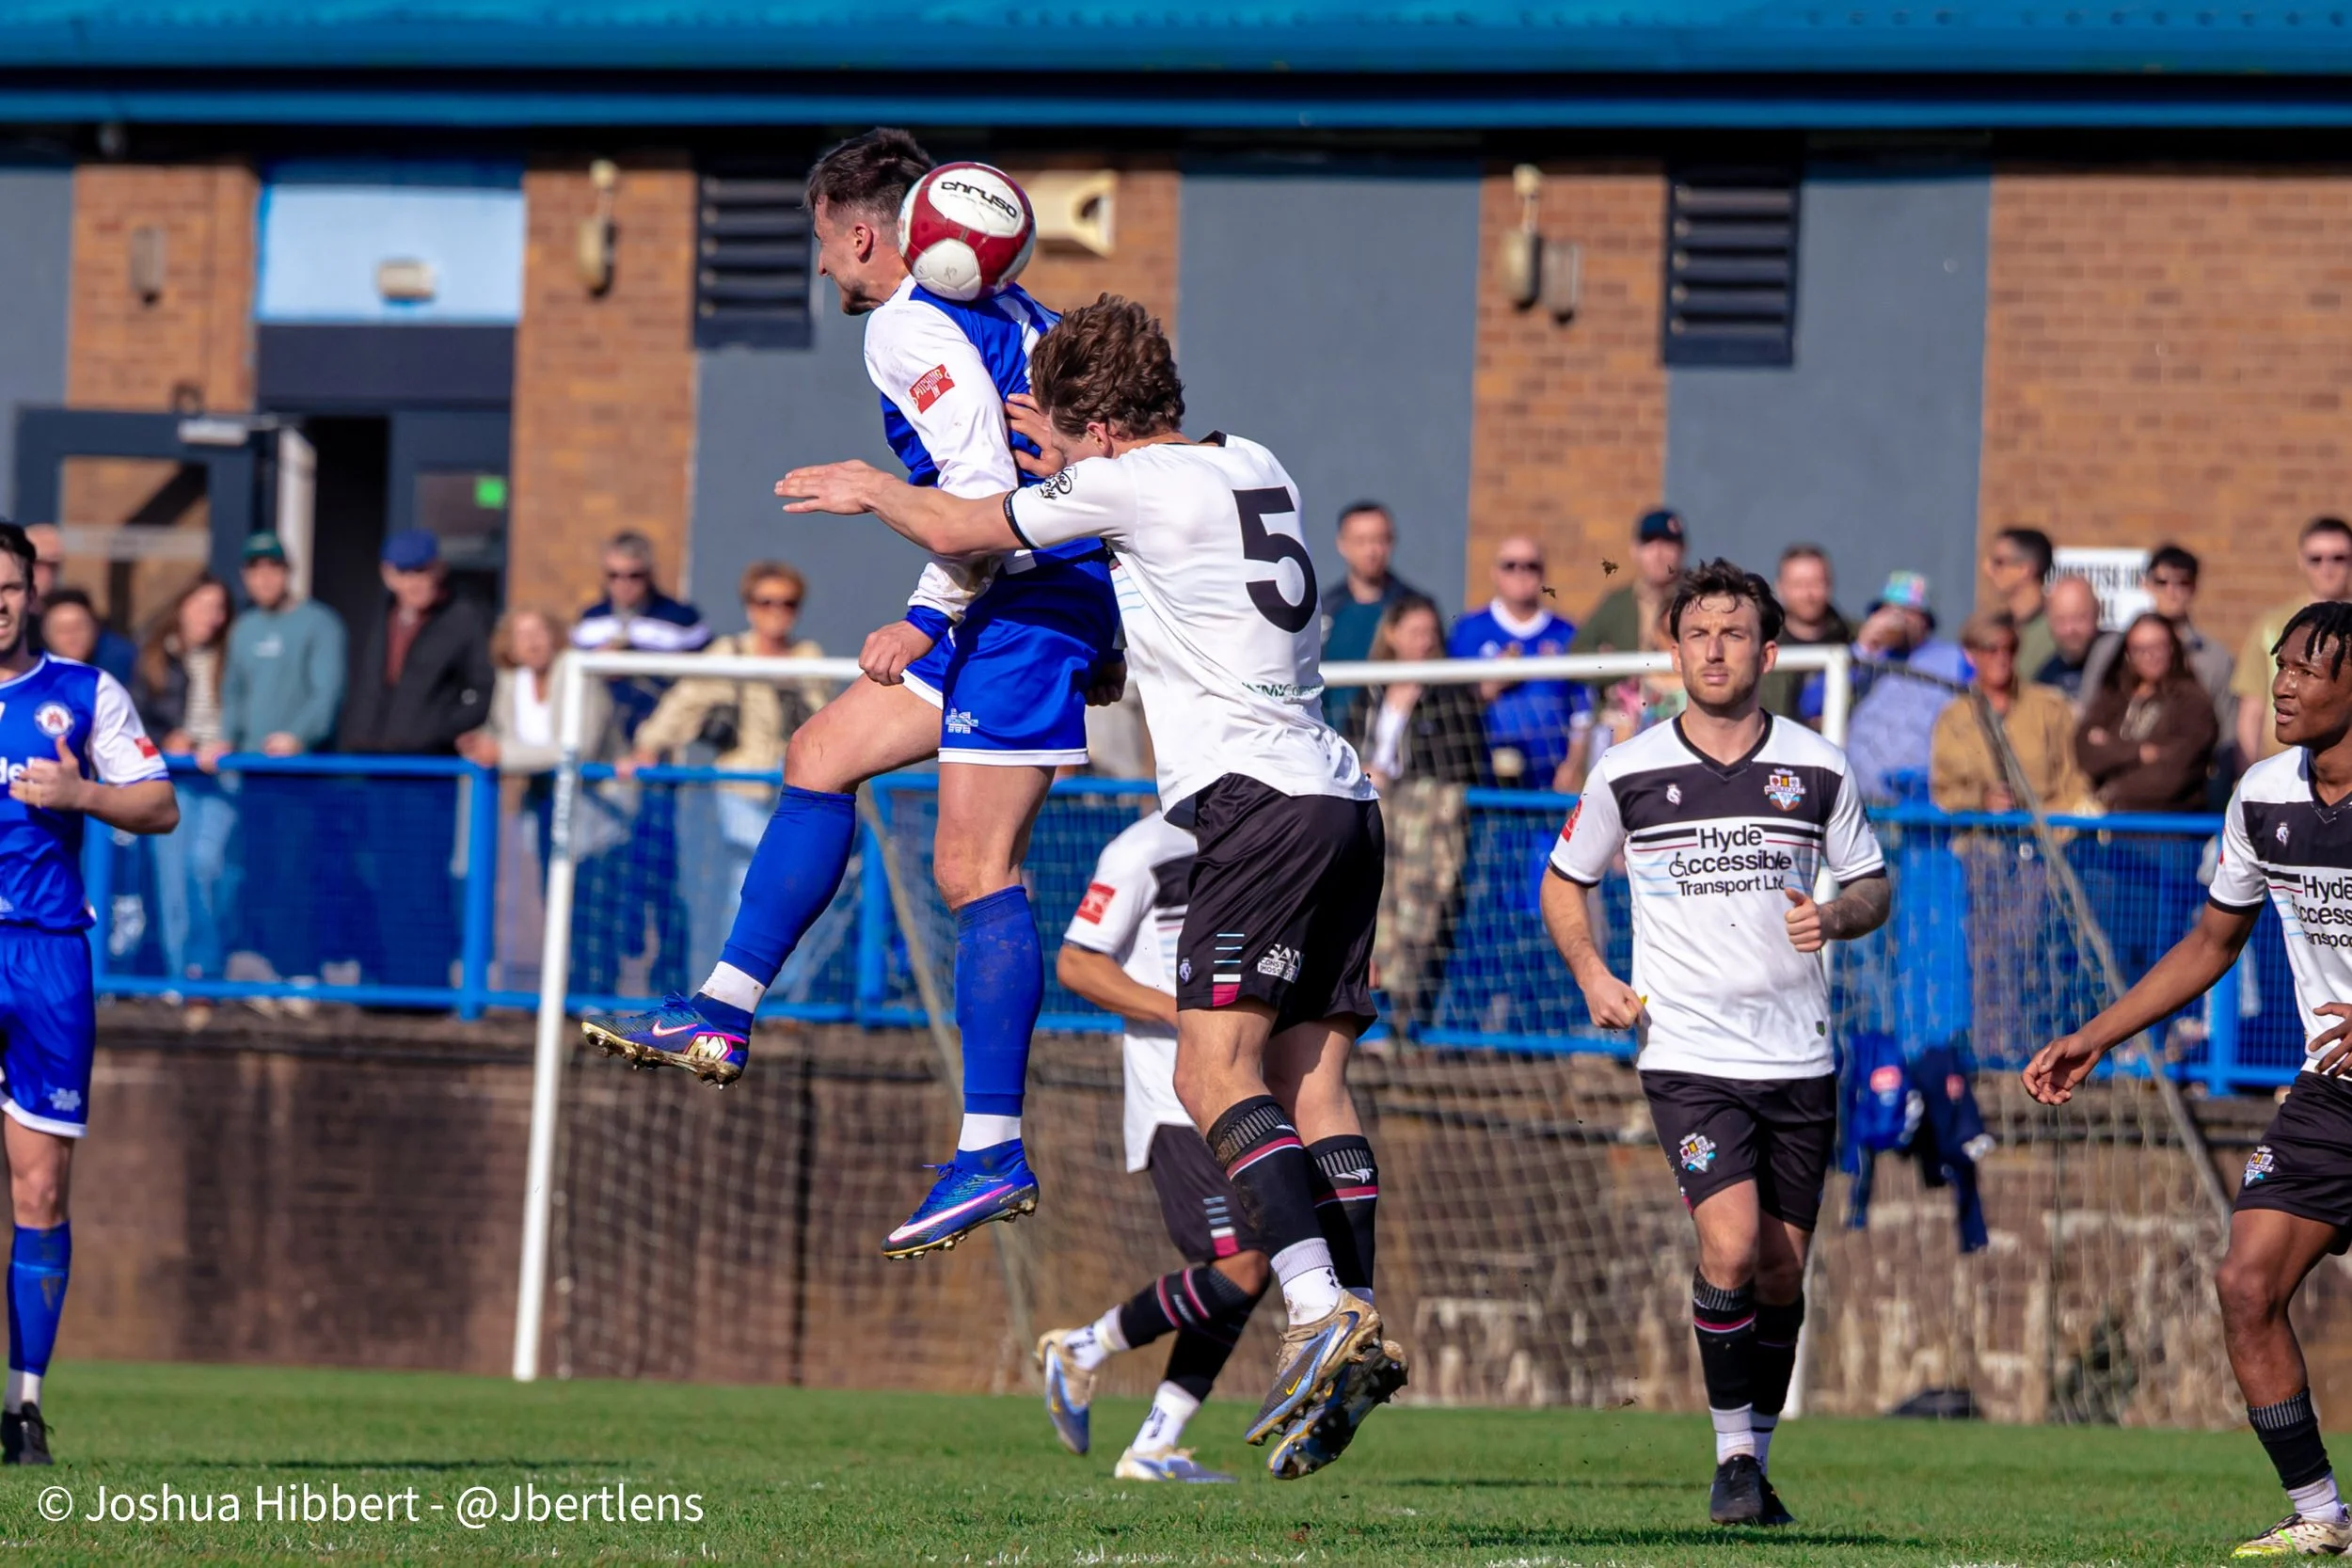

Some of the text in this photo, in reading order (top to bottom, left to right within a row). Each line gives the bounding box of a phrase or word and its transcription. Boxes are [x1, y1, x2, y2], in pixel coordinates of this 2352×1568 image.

[1232, 485, 1317, 634] 5
[1699, 825, 1762, 852] Hyde
[1677, 875, 1760, 896] Transport
